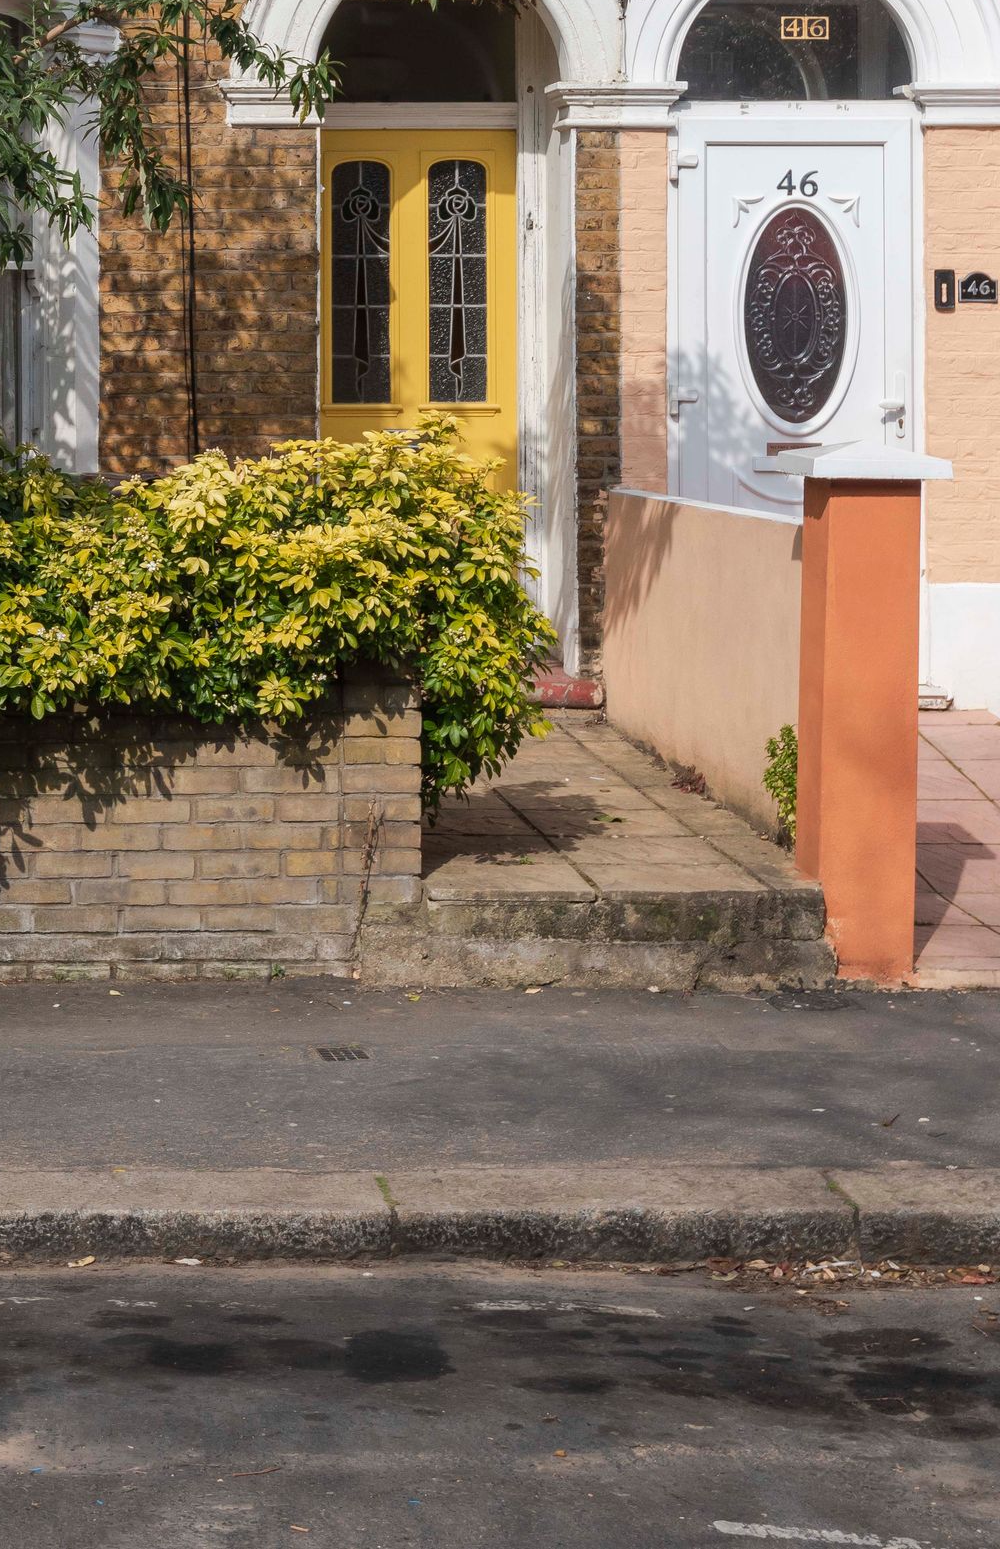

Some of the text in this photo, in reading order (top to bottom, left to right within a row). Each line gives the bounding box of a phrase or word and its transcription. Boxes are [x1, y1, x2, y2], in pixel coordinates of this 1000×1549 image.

[785, 18, 825, 37] 46
[776, 168, 819, 198] 46
[967, 279, 991, 296] 46
